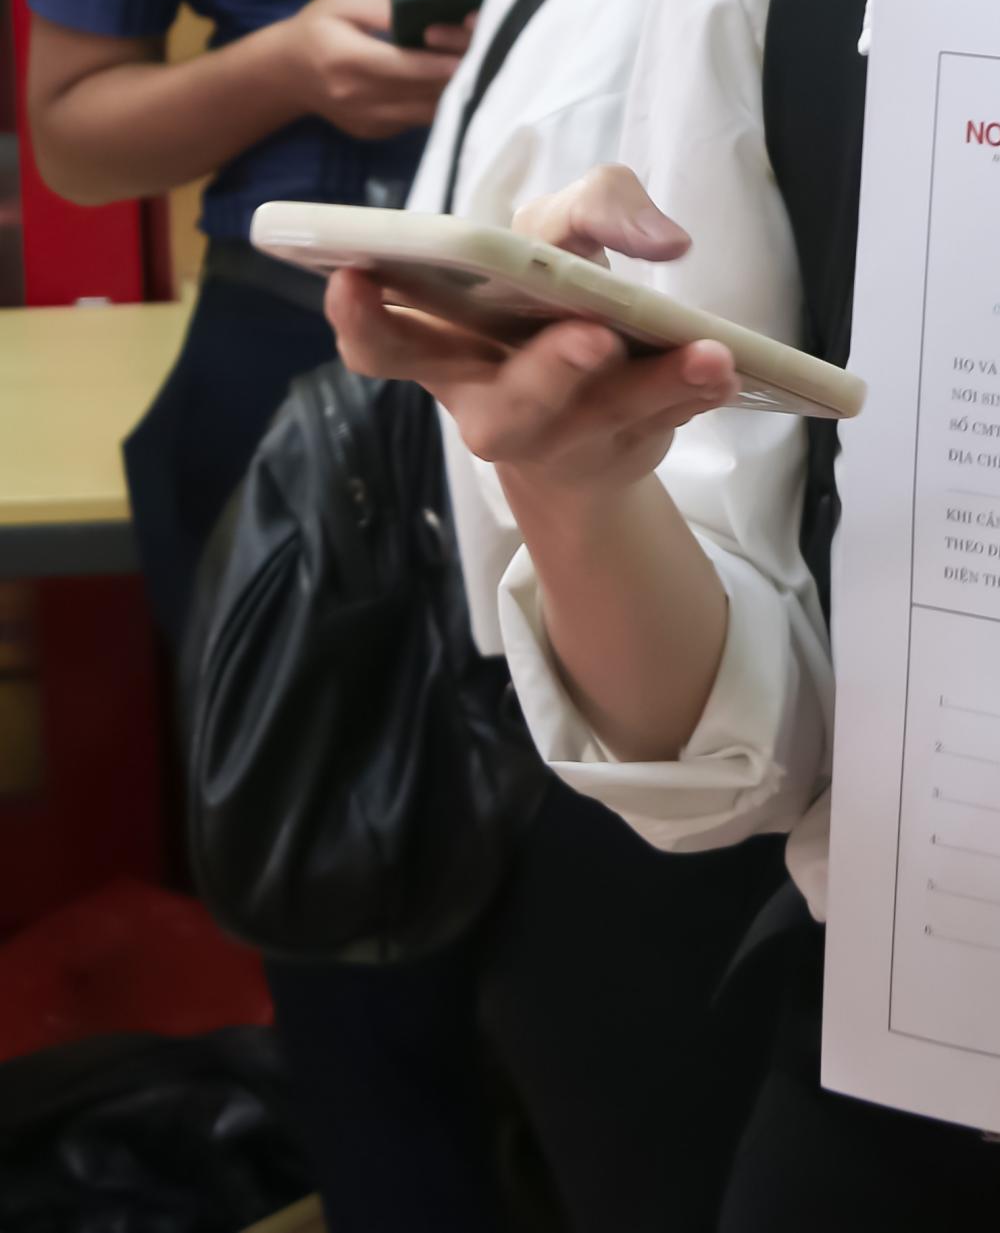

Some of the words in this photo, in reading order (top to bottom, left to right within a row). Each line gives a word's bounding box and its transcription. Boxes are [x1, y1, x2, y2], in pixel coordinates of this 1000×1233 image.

[953, 357, 975, 374] HỌ
[946, 507, 973, 524] KHI
[945, 535, 984, 555] THEO
